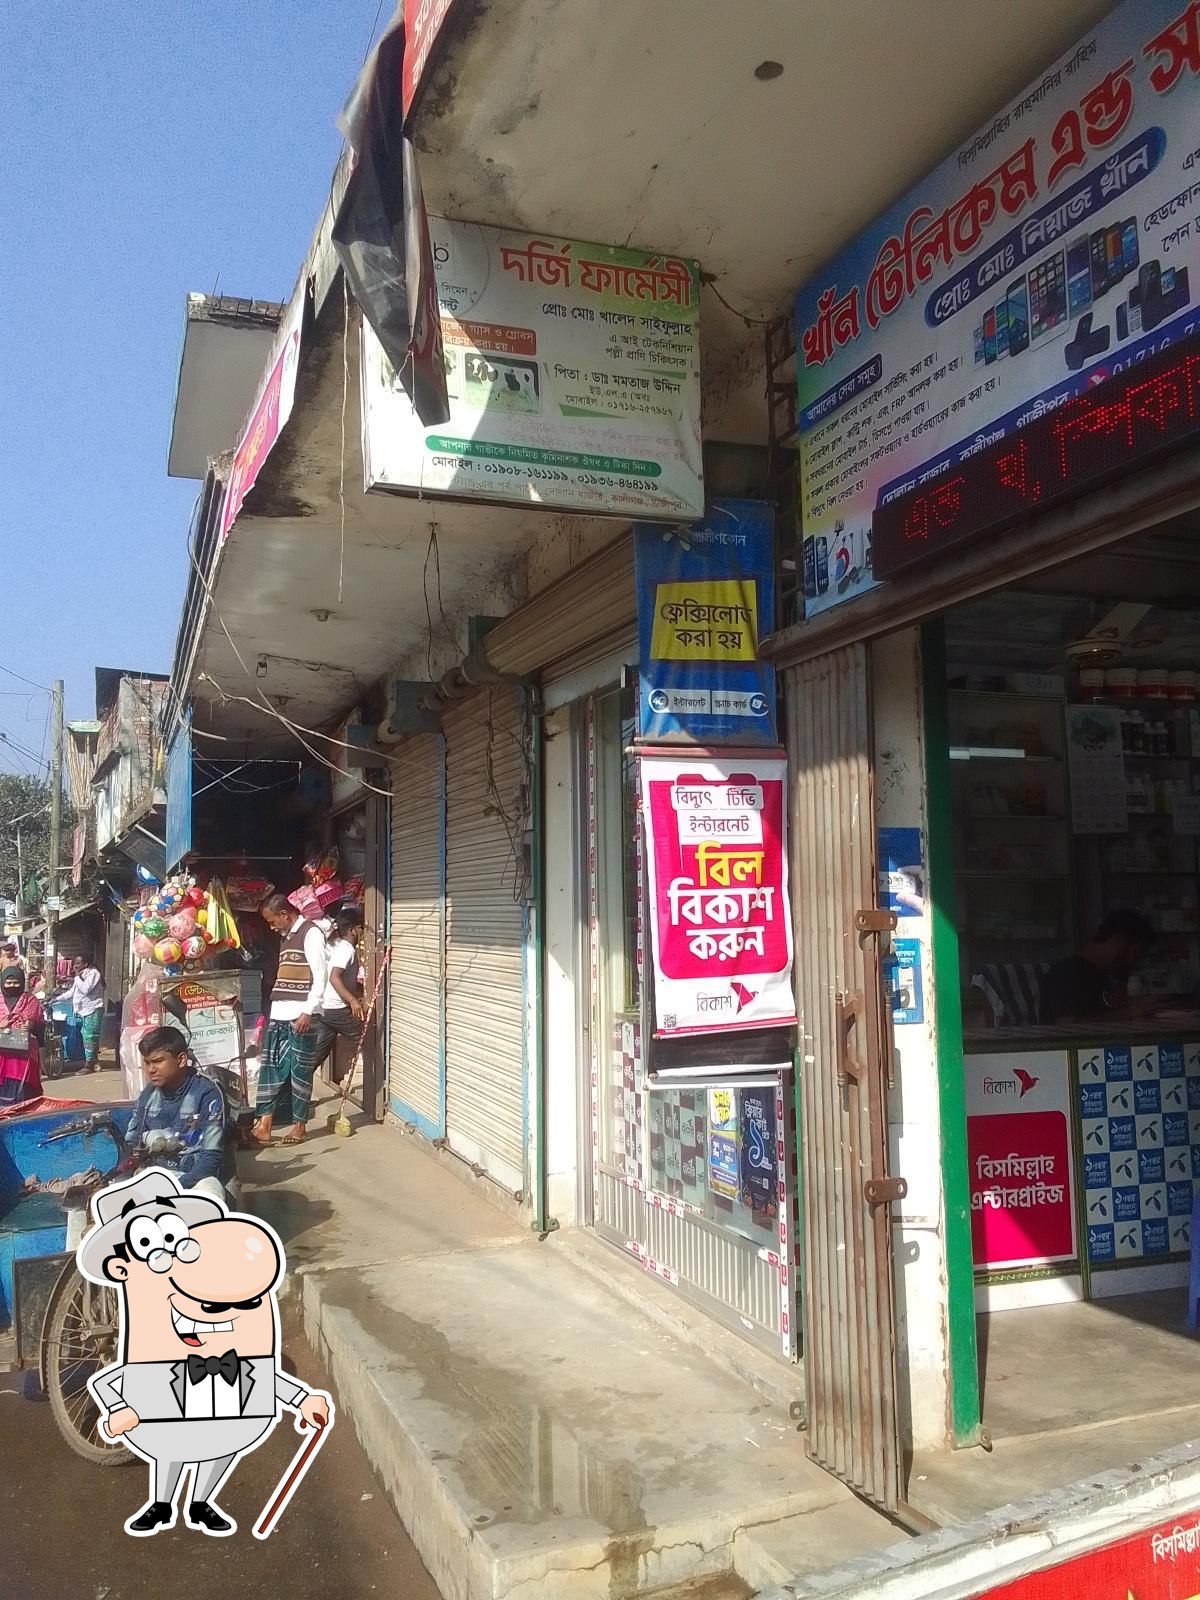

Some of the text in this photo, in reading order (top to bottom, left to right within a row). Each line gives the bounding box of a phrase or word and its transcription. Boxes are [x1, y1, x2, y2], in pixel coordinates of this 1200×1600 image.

[865, 137, 1038, 330] টেলিকম
[500, 240, 692, 307] দর্জি ফার্মেসী
[934, 277, 970, 319] প্রোঃ
[977, 244, 1014, 287] মোঃ
[572, 307, 594, 321] মোঃ
[599, 311, 635, 328] খালেদ
[554, 363, 681, 394] পিতা ডাঃ মমতাজ উদ্দিন
[807, 394, 836, 424] আমাদের
[838, 382, 855, 401] সেবা
[891, 395, 905, 412] FRP
[432, 456, 473, 471] মোবাইল
[675, 627, 743, 649] করা হয়
[675, 786, 756, 809] বিদ্যুৎ টিভি
[689, 815, 750, 832] ইন্টারনেট
[694, 840, 765, 887] বিল
[667, 876, 774, 926] বিকাশ
[686, 926, 765, 961] করুন
[697, 992, 732, 1012] বিকাশ
[983, 1076, 1016, 1094] বিকাশ
[976, 1152, 1055, 1180] বিসমিল্লাহ
[970, 1182, 1065, 1211] এন্টারপ্রাইজ
